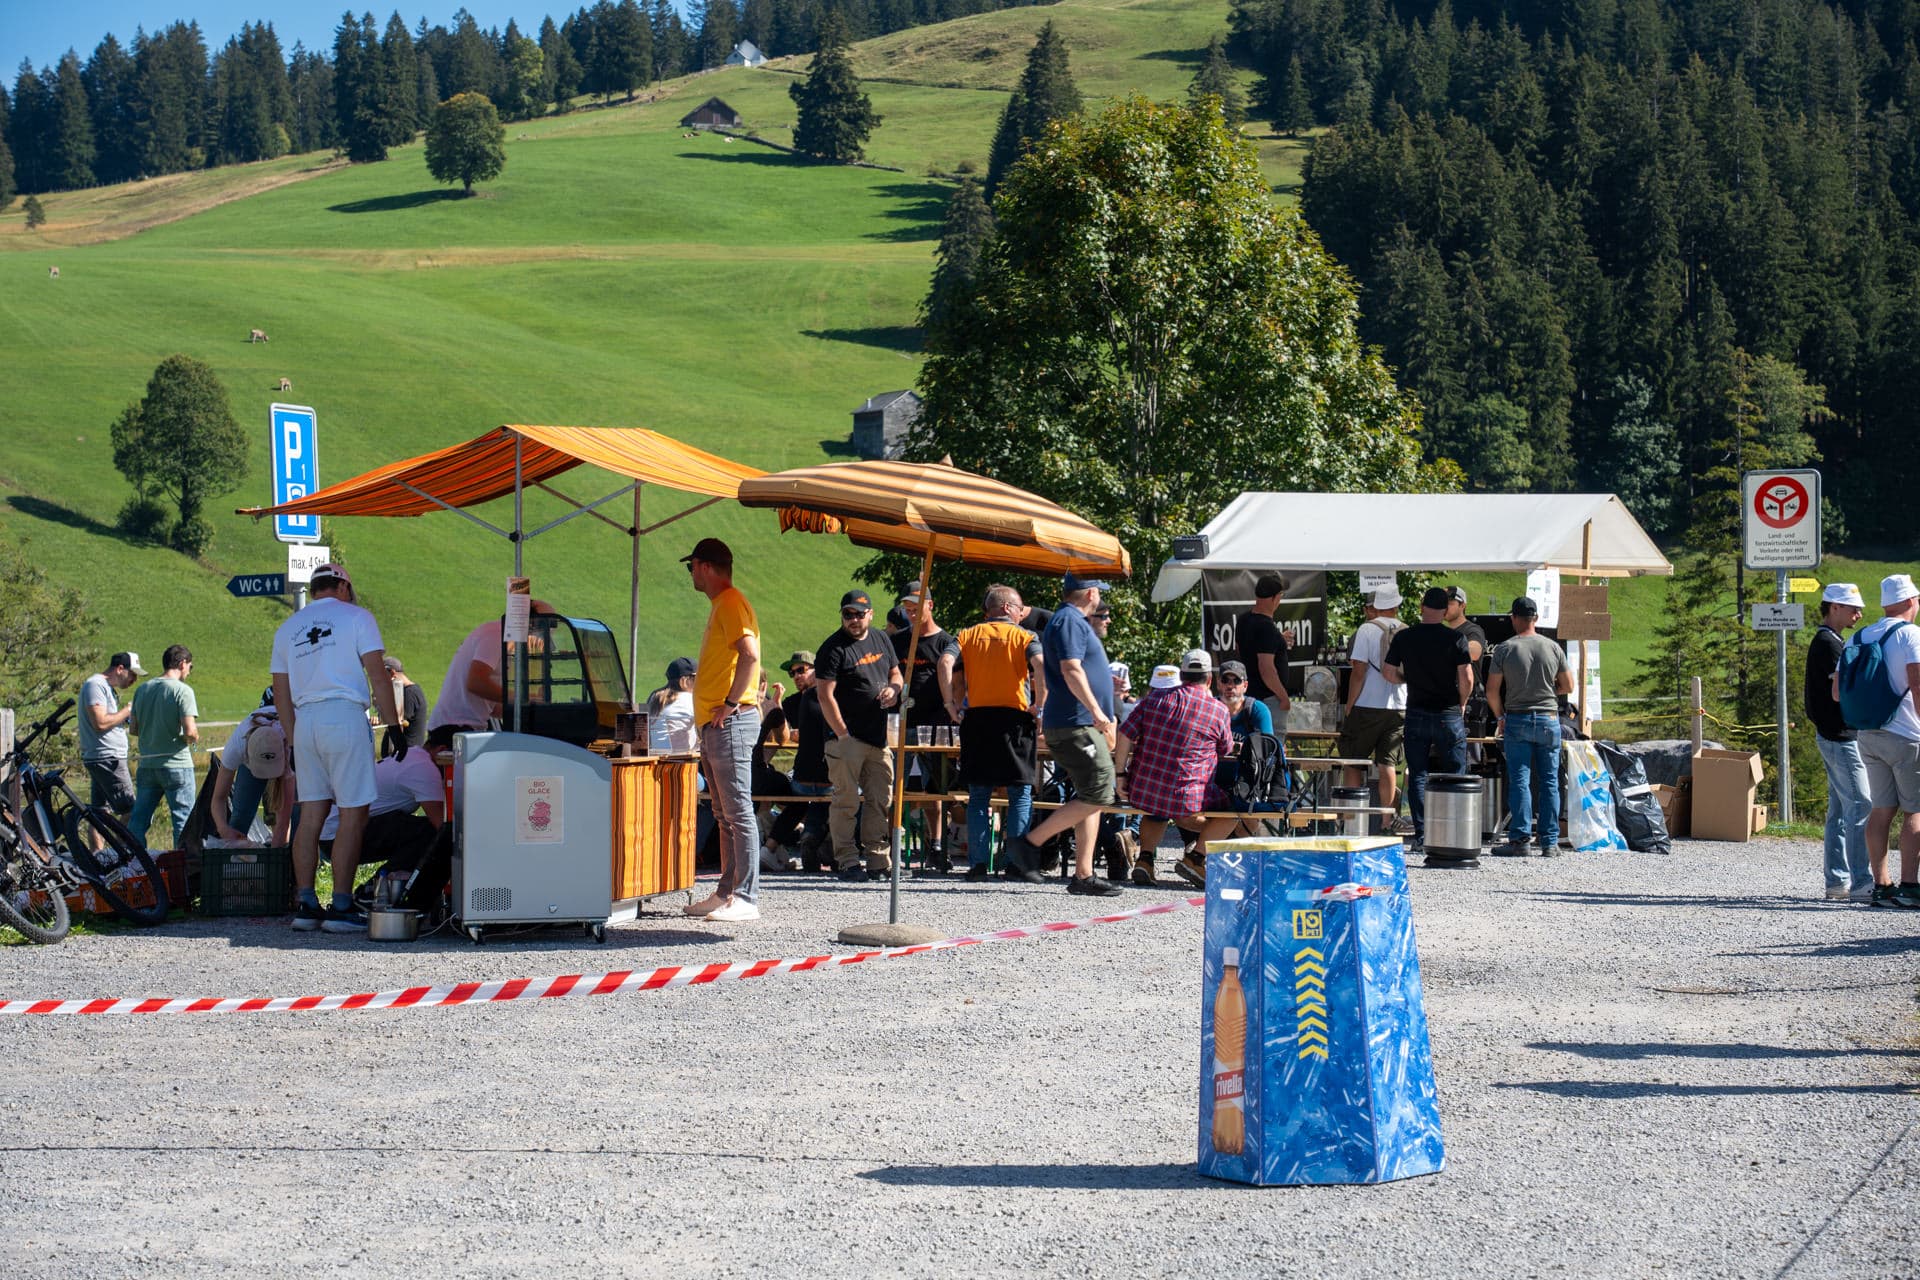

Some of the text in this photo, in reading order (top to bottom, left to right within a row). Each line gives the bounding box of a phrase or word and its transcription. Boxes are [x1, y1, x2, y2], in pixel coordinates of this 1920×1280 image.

[283, 420, 303, 479] P
[291, 558, 308, 570] max.
[308, 556, 313, 570] 4
[238, 578, 262, 593] WC
[1216, 1073, 1242, 1097] rivella
